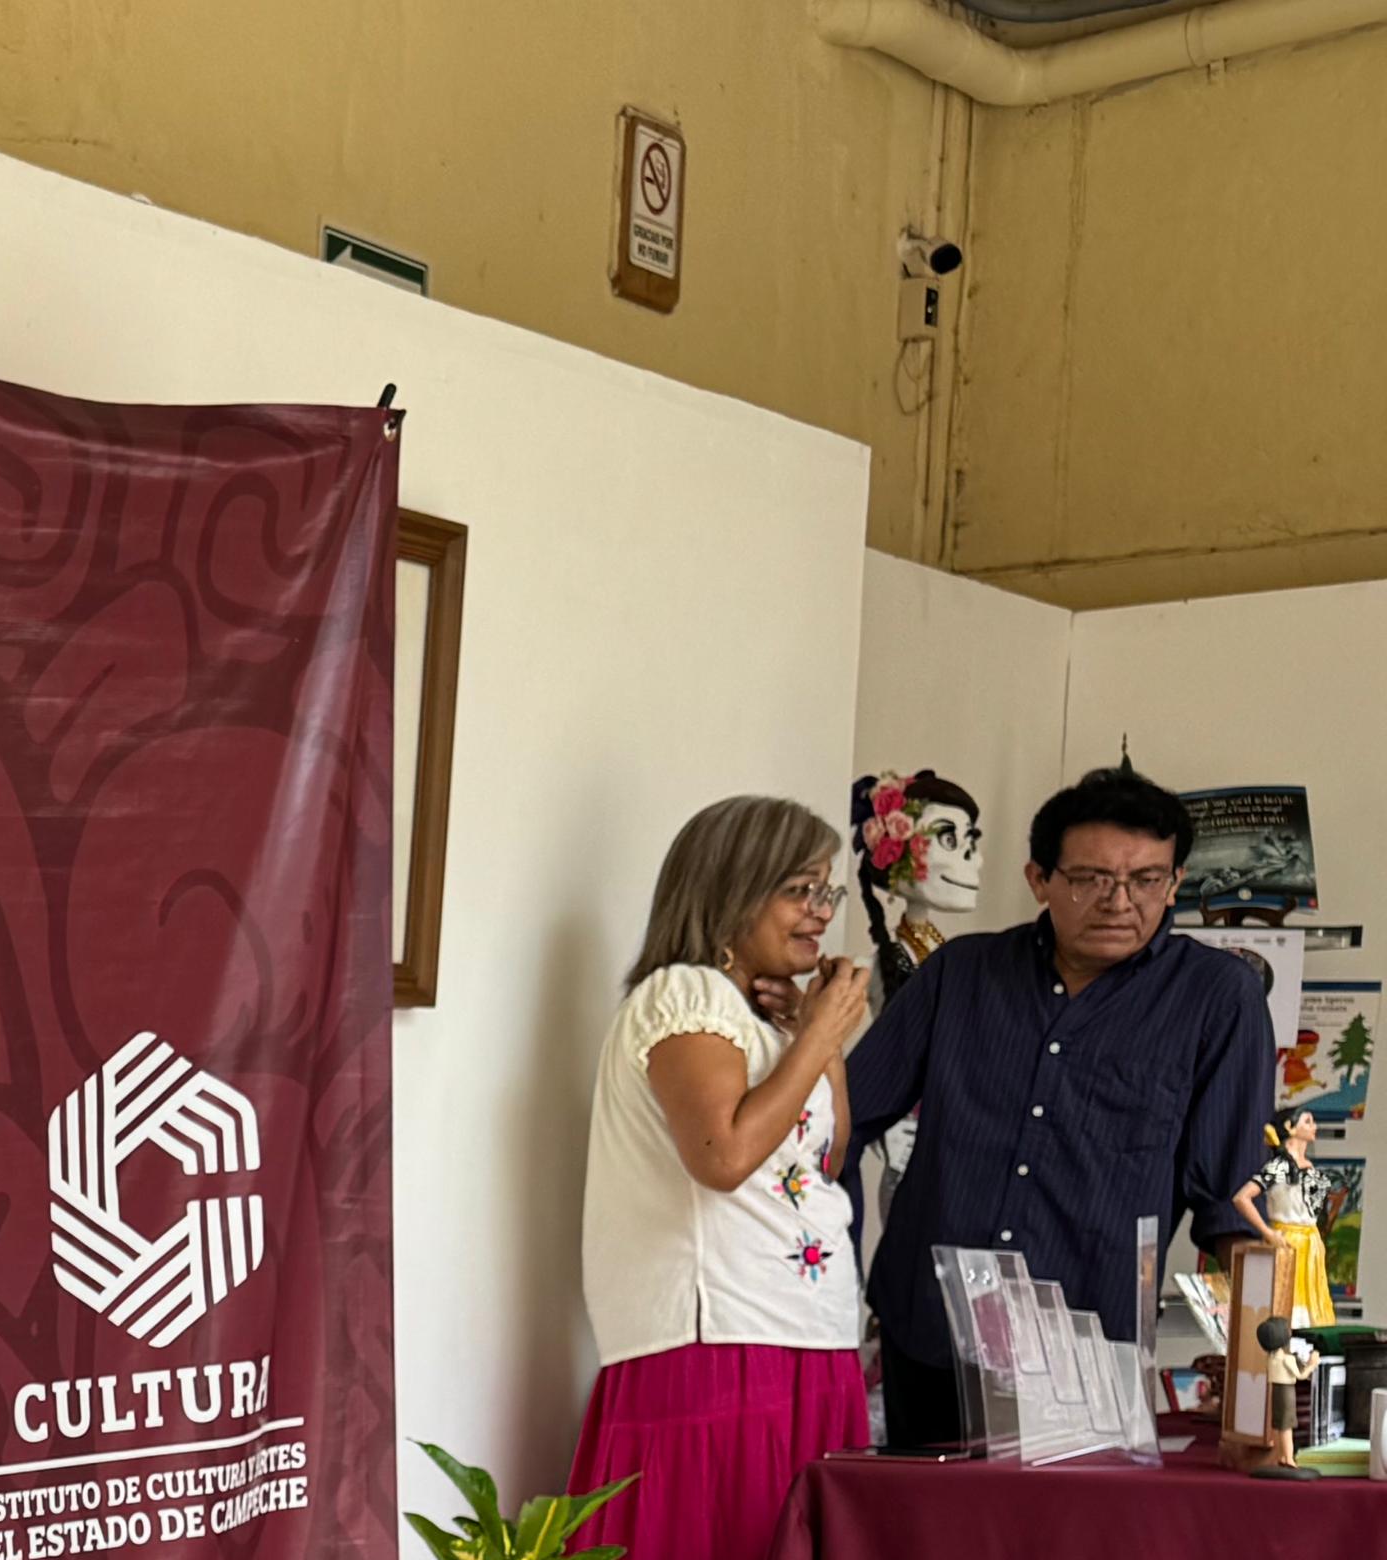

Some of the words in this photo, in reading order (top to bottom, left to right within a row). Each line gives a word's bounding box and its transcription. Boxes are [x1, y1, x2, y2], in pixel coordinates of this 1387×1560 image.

[13, 1355, 271, 1443] CULTURA
[28, 1511, 151, 1560] ESTADO
[158, 1504, 206, 1542] DE
[210, 1476, 309, 1535] CAMPECHE
[106, 1476, 141, 1507] DE
[146, 1459, 247, 1499] CULTURA
